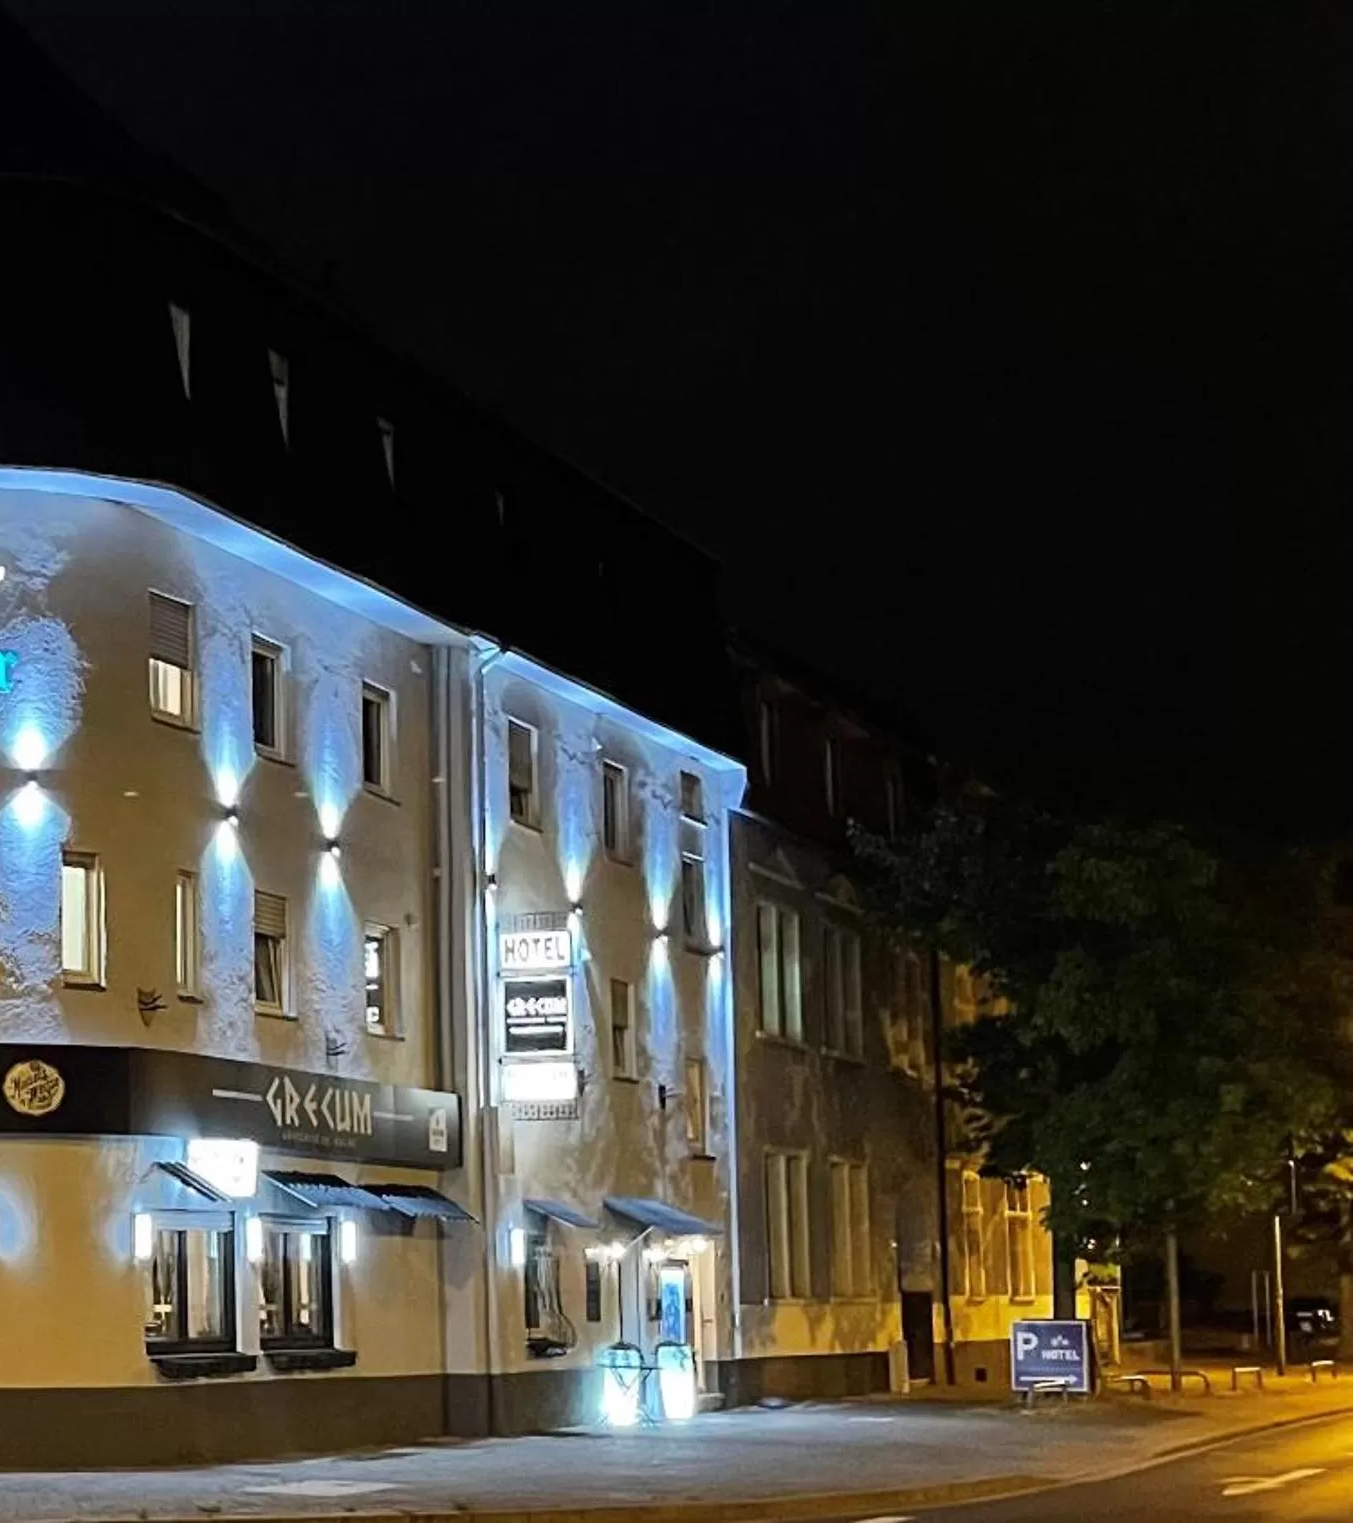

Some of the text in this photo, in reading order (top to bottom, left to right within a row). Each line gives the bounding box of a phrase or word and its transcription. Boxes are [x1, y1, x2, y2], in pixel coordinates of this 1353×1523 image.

[504, 936, 566, 963] HOTEL
[265, 1074, 373, 1137] GRECUM
[1016, 1331, 1039, 1361] P
[1041, 1349, 1081, 1361] HOTEL
